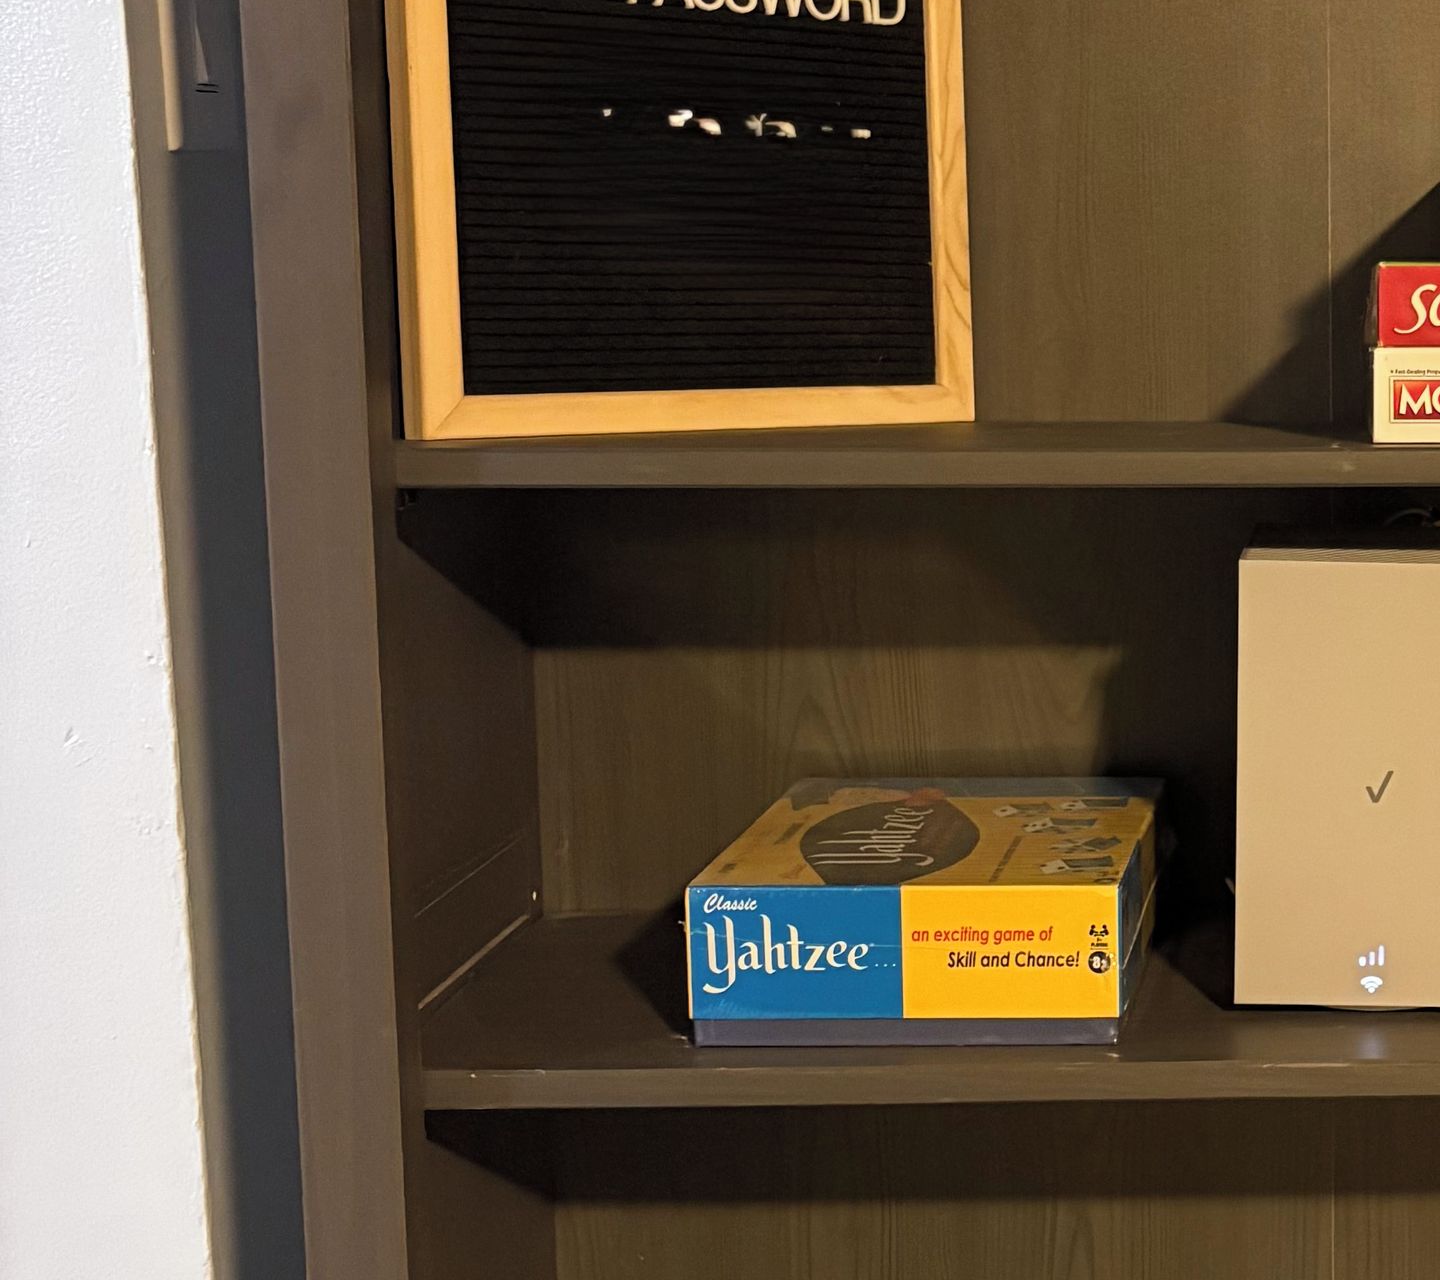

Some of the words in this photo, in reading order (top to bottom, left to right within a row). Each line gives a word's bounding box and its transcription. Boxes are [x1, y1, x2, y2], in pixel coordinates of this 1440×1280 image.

[807, 807, 935, 867] Yahtzee
[703, 893, 757, 913] Classic
[911, 928, 929, 942] an
[934, 926, 989, 945] exciting
[993, 928, 1035, 945] game
[1039, 926, 1053, 941] of
[948, 951, 976, 968] Skill
[980, 951, 1010, 968] and
[1015, 950, 1080, 968] Chance!
